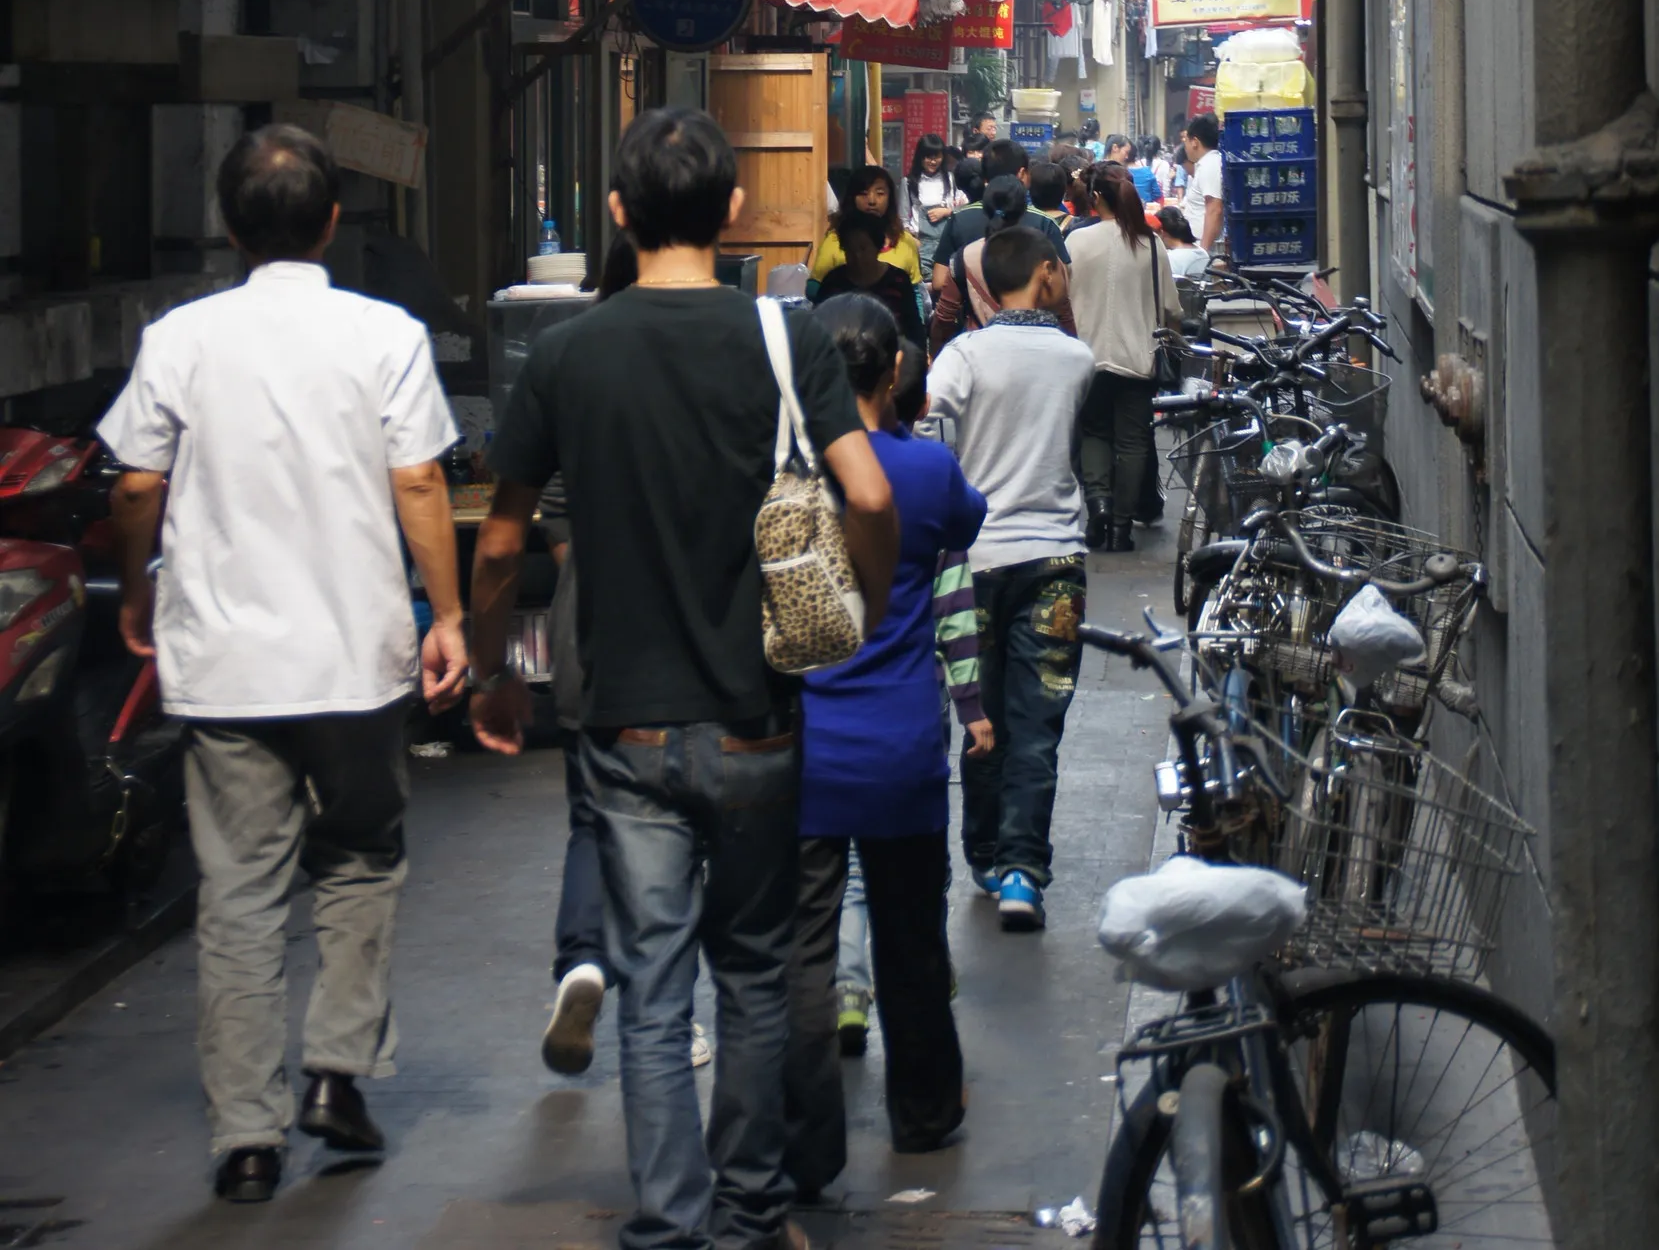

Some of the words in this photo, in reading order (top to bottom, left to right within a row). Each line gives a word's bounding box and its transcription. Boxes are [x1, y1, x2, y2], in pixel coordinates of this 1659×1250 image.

[1250, 141, 1298, 154] 百事可乐
[1251, 191, 1300, 205] 百事可乐
[1253, 241, 1302, 255] 百事可乐
